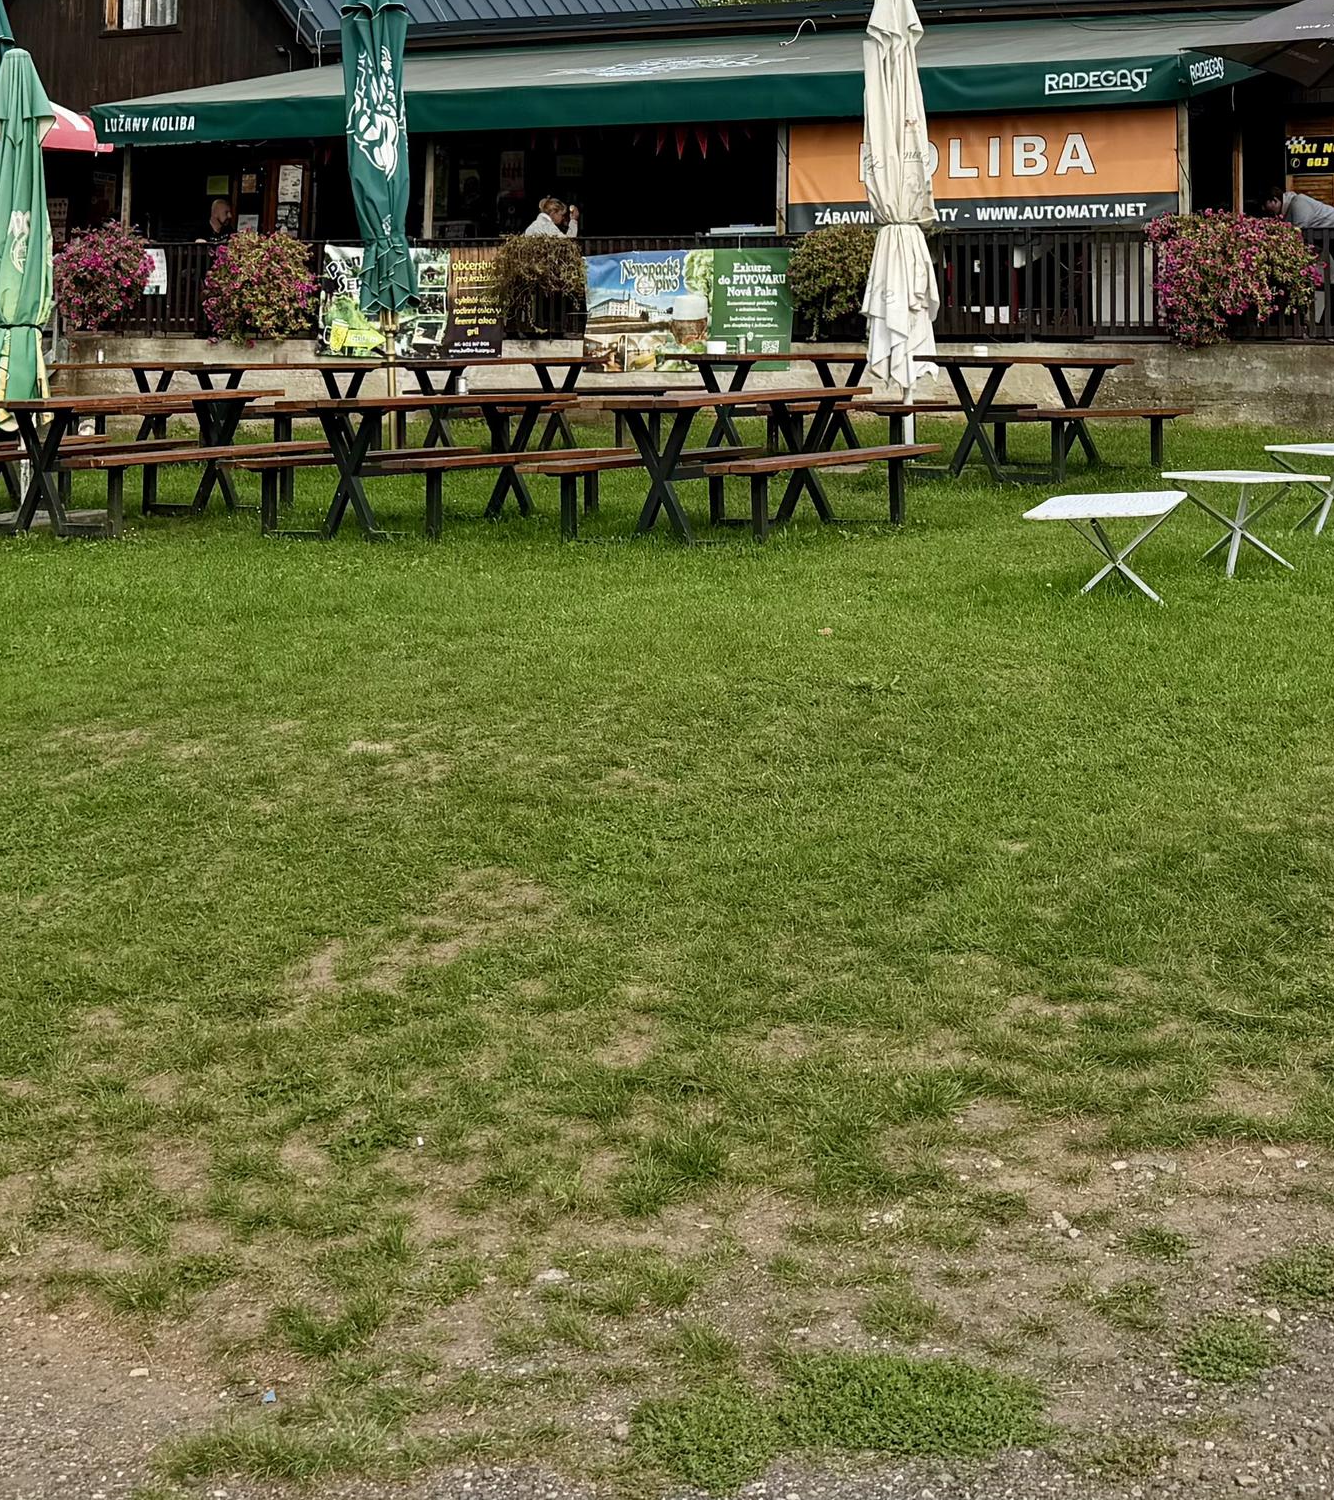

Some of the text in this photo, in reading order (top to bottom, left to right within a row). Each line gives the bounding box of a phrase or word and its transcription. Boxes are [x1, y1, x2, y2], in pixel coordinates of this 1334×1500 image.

[1044, 67, 1153, 95] RADEGAST
[104, 114, 195, 133] LUŽANY KOLIBA
[858, 132, 1097, 183] LIBA
[1290, 143, 1317, 154] TAXI
[976, 202, 1147, 222] WWW.AUTOMATY.NET
[620, 256, 680, 284] Novopacké
[718, 273, 786, 285] do PIVOVARU
[654, 277, 680, 296] pivo
[726, 285, 778, 297] Nová Paka
